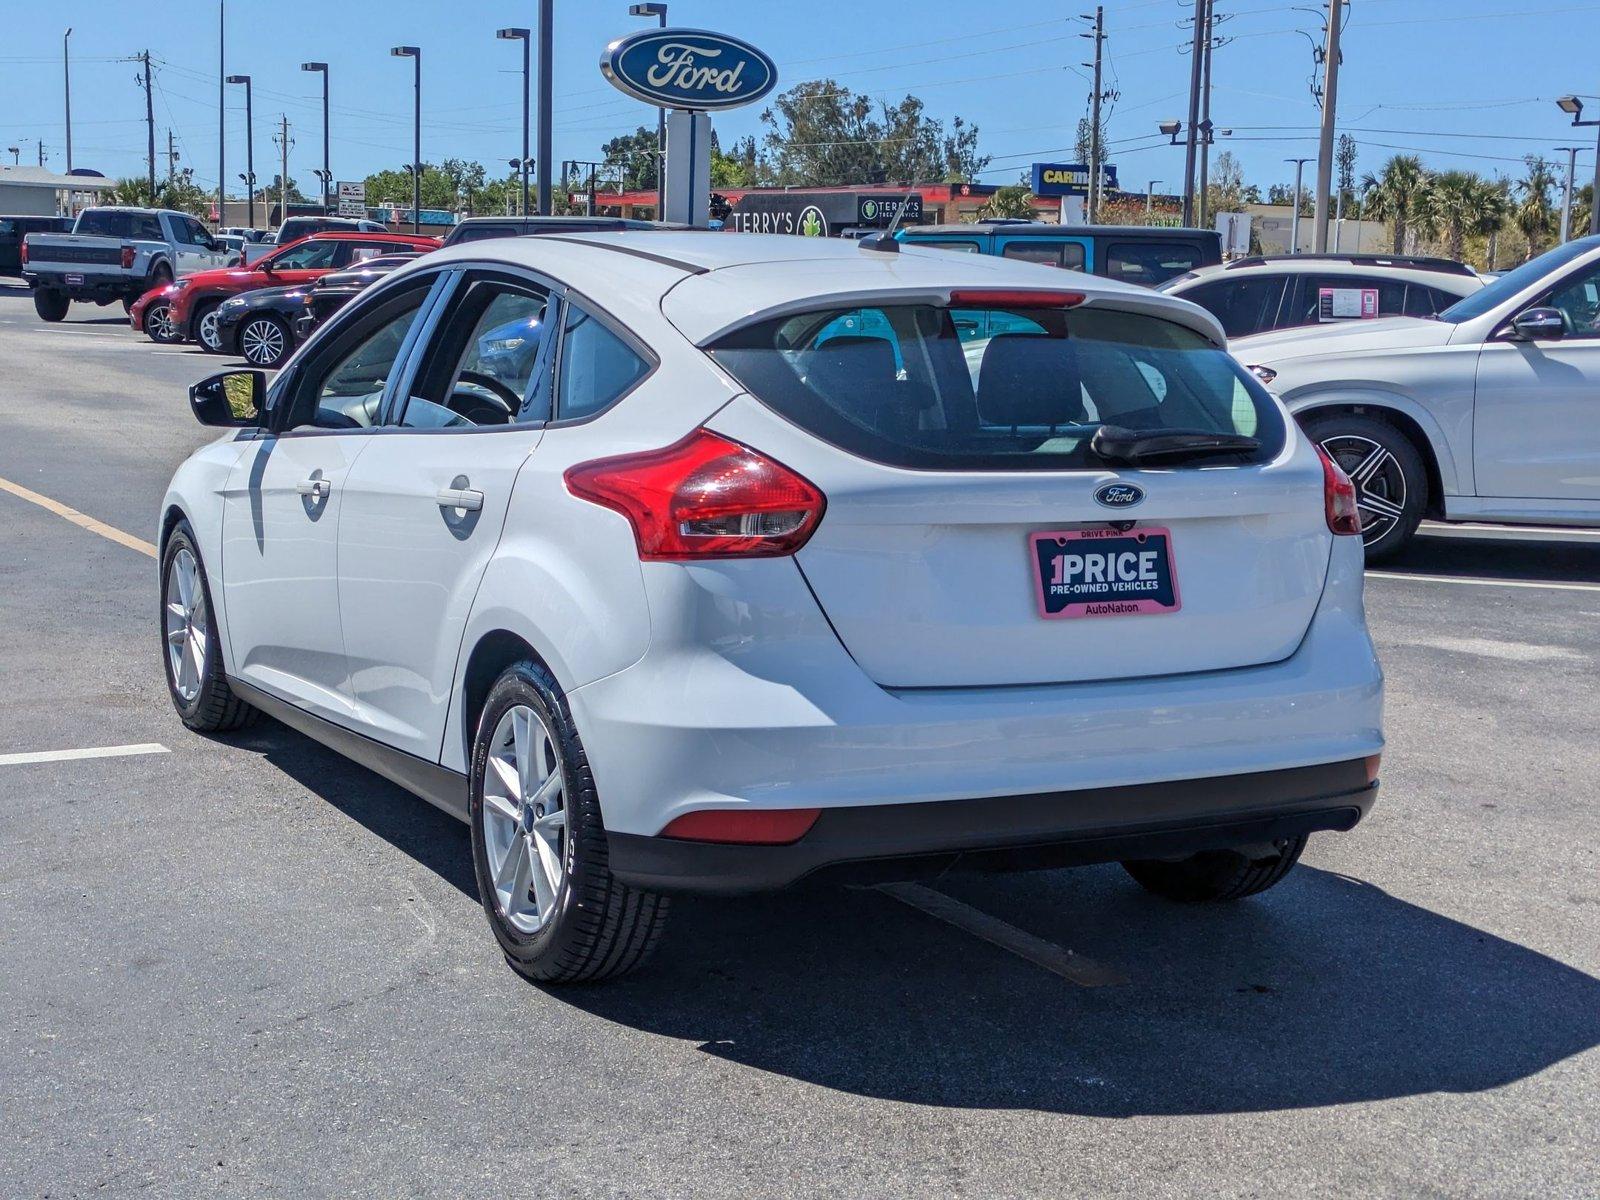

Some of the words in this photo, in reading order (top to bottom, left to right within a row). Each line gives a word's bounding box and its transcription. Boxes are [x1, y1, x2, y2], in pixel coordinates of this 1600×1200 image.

[647, 43, 746, 93] Ford
[1043, 170, 1108, 185] CARmx
[733, 212, 793, 233] TERRY'S
[1105, 487, 1135, 502] Ford
[1081, 530, 1104, 538] DRIVE
[1050, 551, 1158, 584] 1PRICE
[1050, 583, 1109, 595] PRE-OWNED
[1112, 581, 1159, 592] VEHICLES
[1086, 603, 1139, 615] AutoNation
